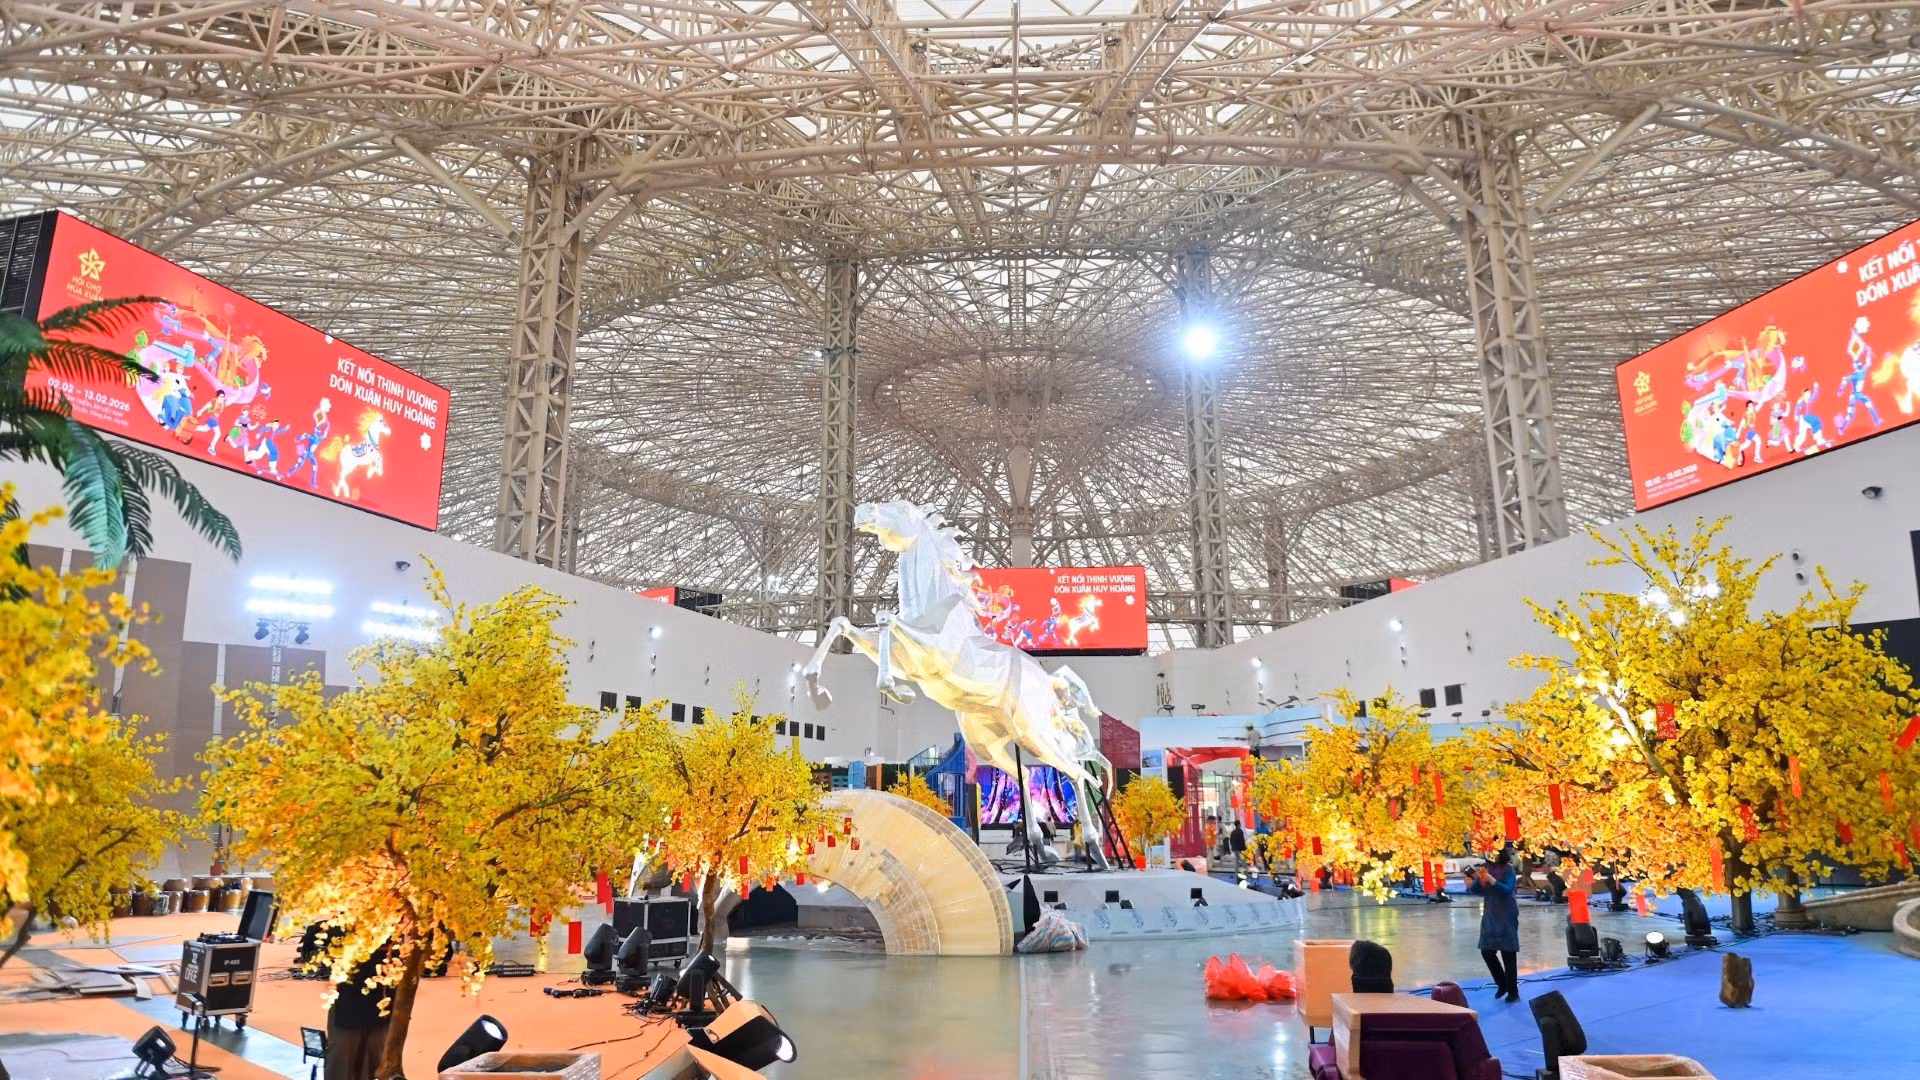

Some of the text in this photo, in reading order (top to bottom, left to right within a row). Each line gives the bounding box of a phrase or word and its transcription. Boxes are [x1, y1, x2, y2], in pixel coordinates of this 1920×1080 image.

[1859, 240, 1916, 283] KẾT NỐI
[1856, 281, 1890, 307] ĐÓN
[48, 377, 74, 393] 02.02
[84, 389, 130, 411] 13.02.2026
[330, 374, 436, 430] ĐÓN XUÂN HUY HOÀNG
[337, 357, 438, 413] KẾT NỐI THỊNH VƯỢNG
[1054, 584, 1136, 593] ĐÓN XUÂN HUY HOÀNG
[1057, 573, 1070, 583] KẾT
[1071, 573, 1085, 583] NỐI
